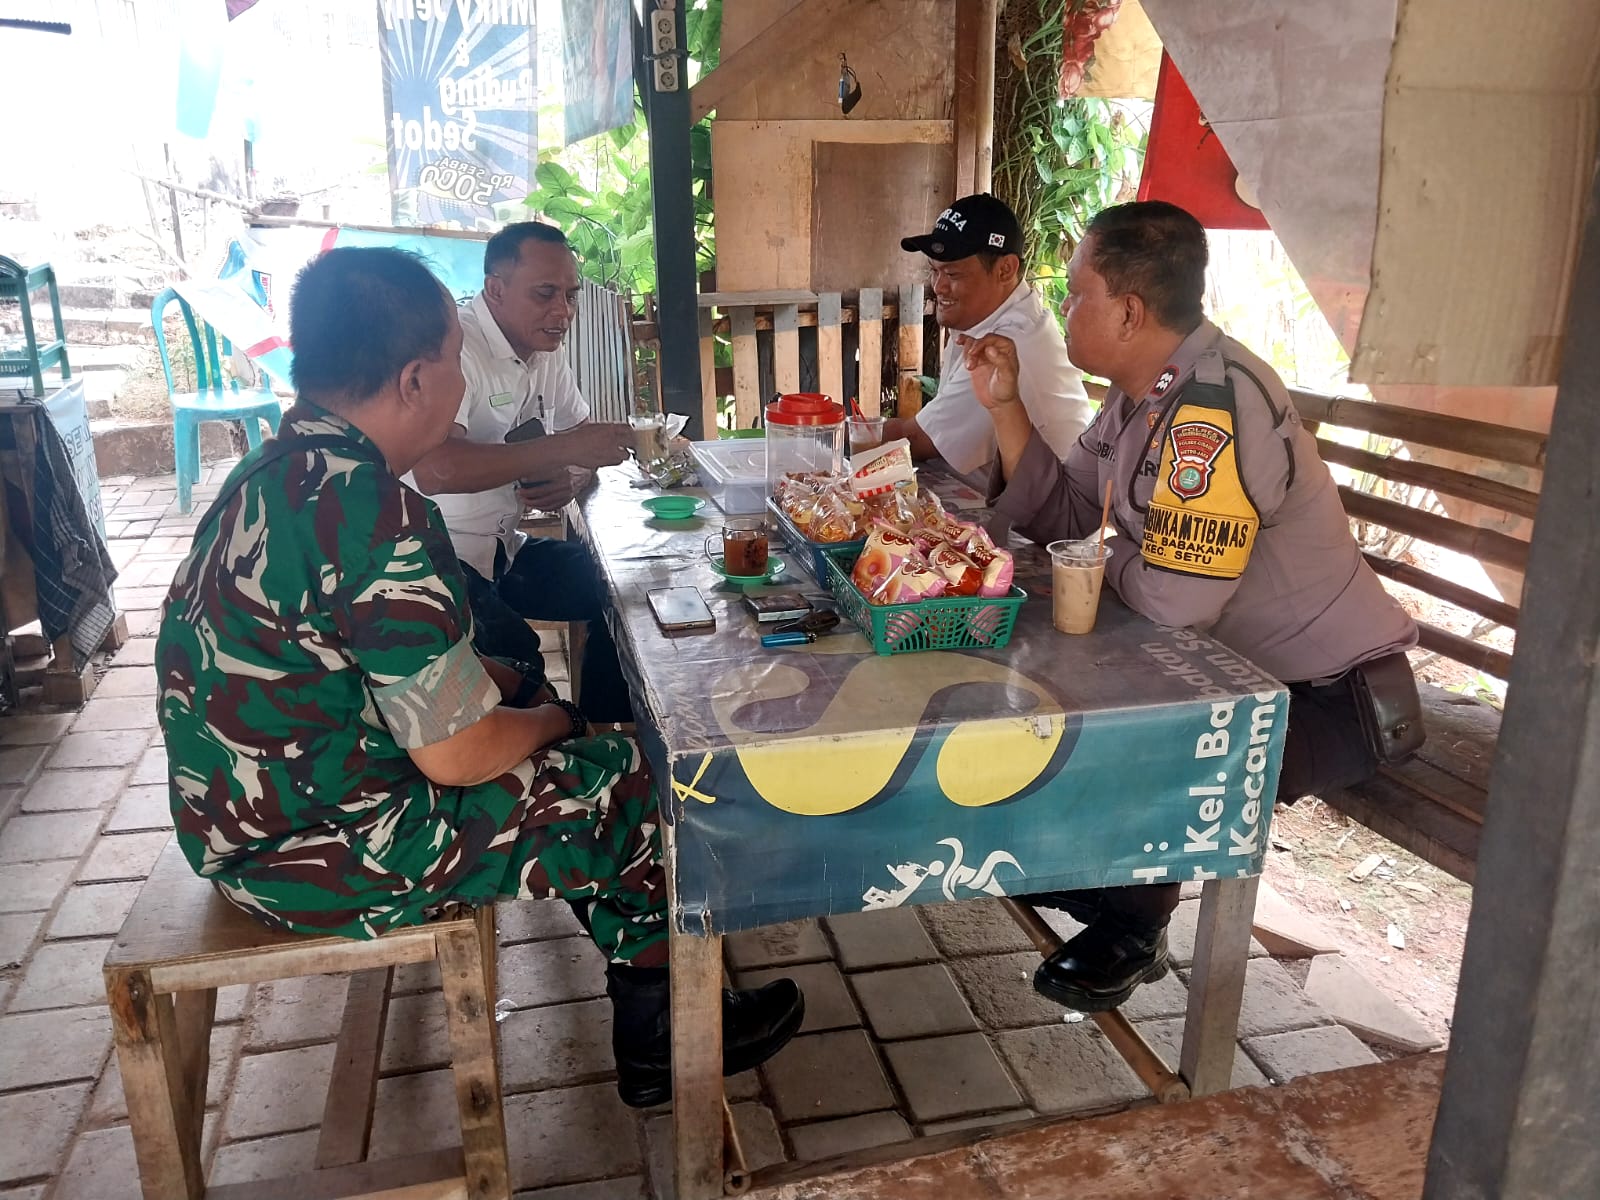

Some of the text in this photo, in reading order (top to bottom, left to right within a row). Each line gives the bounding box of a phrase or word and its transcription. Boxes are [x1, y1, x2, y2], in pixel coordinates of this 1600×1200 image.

[1145, 543, 1212, 565] KEC. SETU
[1161, 537, 1225, 557] BABAKAN
[1183, 771, 1227, 853] Kel.
